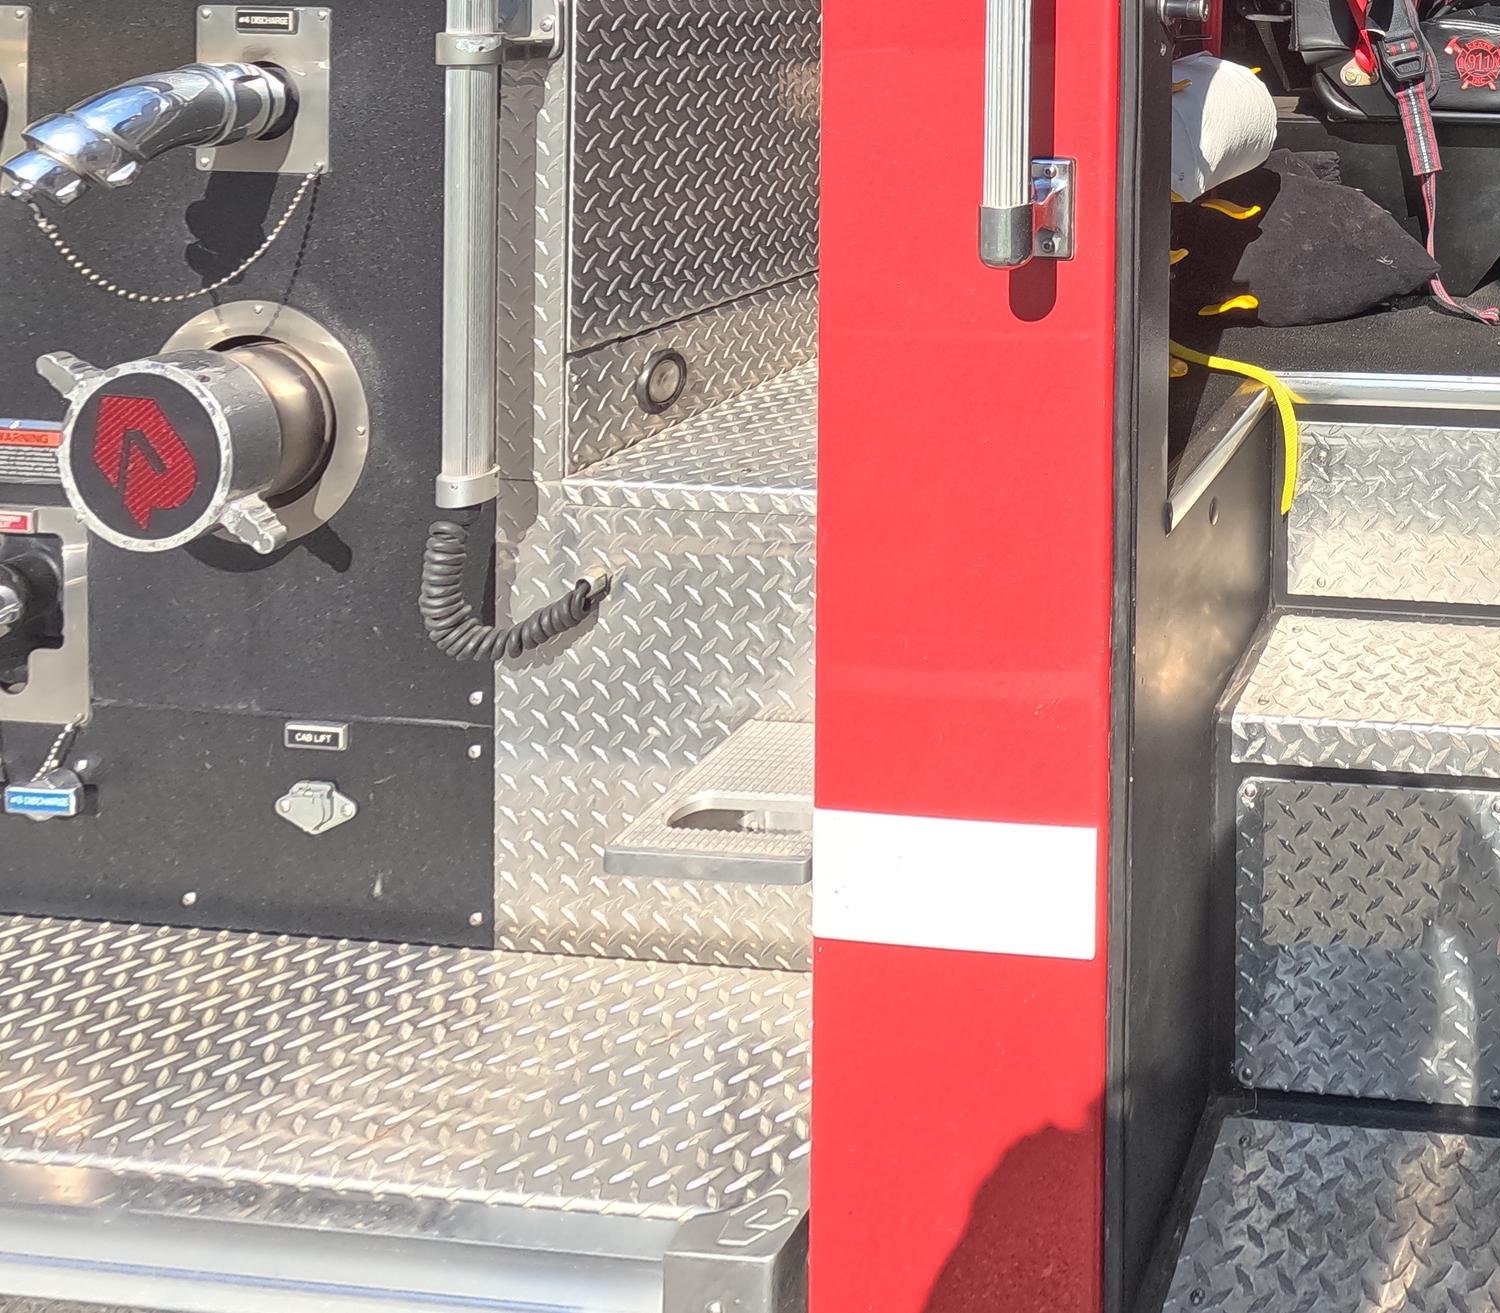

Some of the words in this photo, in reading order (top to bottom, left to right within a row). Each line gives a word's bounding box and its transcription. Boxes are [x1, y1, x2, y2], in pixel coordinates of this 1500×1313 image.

[250, 16, 289, 25] DISCHARGE
[1468, 53, 1491, 72] 911
[295, 733, 313, 742] CAB
[314, 734, 332, 743] LIFT
